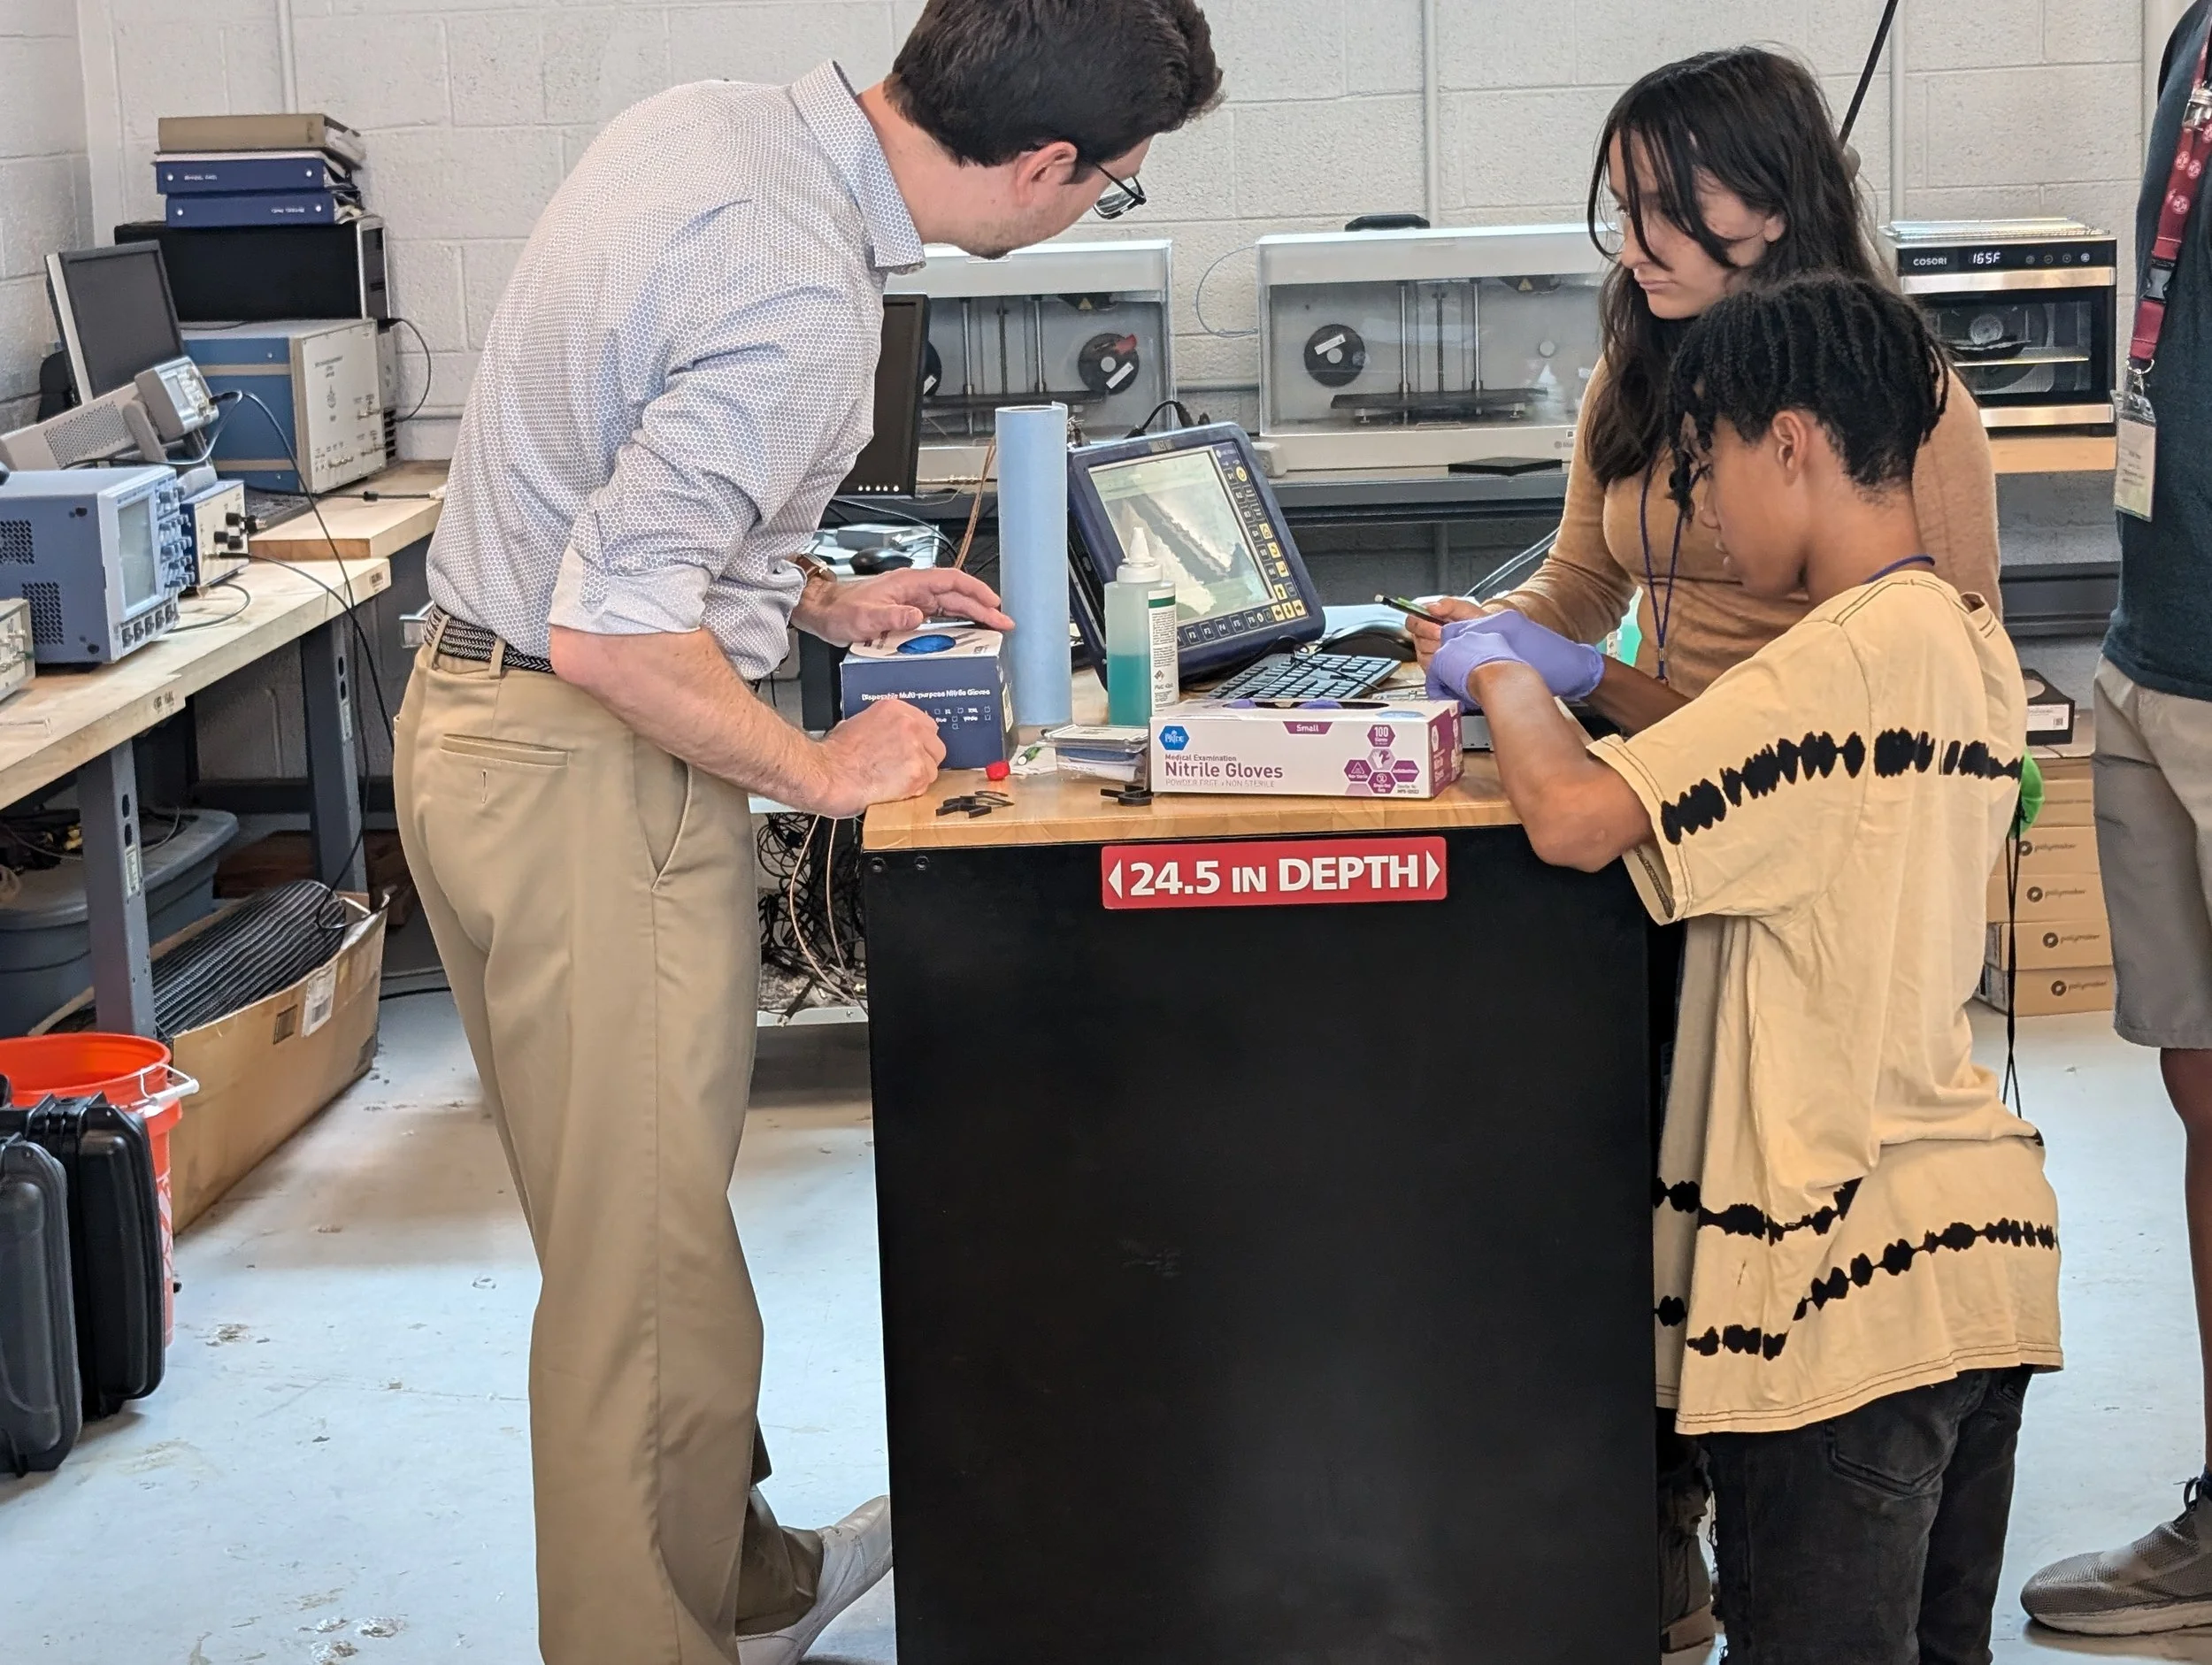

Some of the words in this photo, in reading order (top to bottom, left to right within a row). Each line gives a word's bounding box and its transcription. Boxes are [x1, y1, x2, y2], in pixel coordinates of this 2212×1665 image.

[1913, 257, 1947, 266] COSORI
[1972, 251, 2001, 264] 165F
[1296, 724, 1319, 733] Small
[1374, 726, 1389, 738] 100
[1165, 761, 1220, 778] Nitrile
[1225, 762, 1284, 779] Gloves
[1129, 860, 1221, 896] 24.5
[1231, 865, 1267, 894] IN
[1278, 853, 1419, 893] DEPTH
